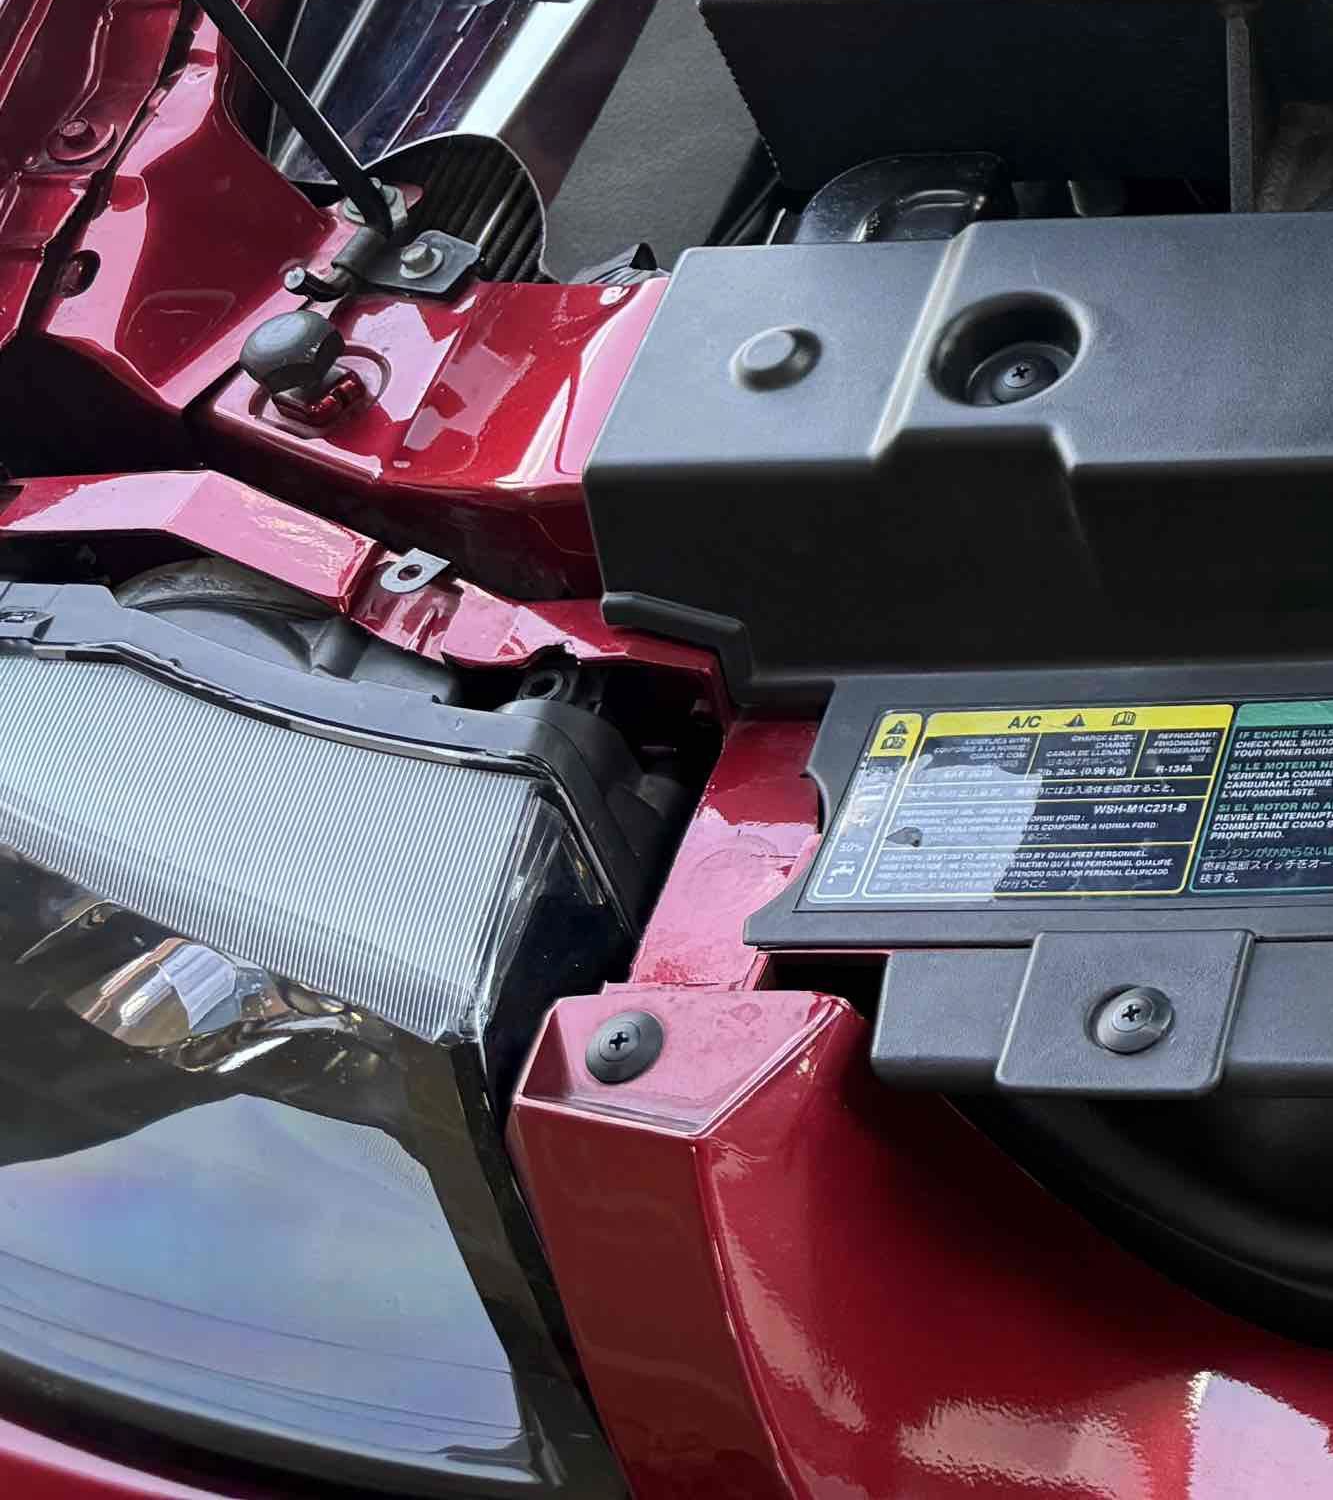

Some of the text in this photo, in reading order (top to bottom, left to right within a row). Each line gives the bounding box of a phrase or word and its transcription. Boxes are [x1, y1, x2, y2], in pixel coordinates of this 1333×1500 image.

[1008, 715, 1042, 729] A/C
[1238, 730, 1250, 739] IF
[1253, 729, 1297, 739] ENGINE
[1236, 740, 1270, 749] CHECK
[1272, 739, 1299, 748] FUEL
[1234, 748, 1262, 757] YOUR
[1264, 747, 1302, 757] OWNER
[1229, 762, 1243, 771] SI
[1246, 761, 1261, 770] LE
[1264, 760, 1317, 770] MOTEUR
[1275, 771, 1290, 780] LA
[1294, 778, 1332, 788] COMME
[1218, 803, 1232, 812] SI
[1234, 803, 1249, 812] EL
[1252, 802, 1298, 812] MOTOR
[1301, 801, 1319, 811] NO
[1215, 812, 1253, 822] REVISE
[1254, 812, 1269, 821] EL
[1213, 820, 1290, 831] COMBUSTIBLE
[1292, 820, 1324, 829] COMO
[1210, 830, 1285, 840] PROPIETARIO.
[1035, 851, 1046, 859] BY
[1048, 850, 1094, 859] QUALIFIED
[1086, 859, 1134, 868] PERSONNEL
